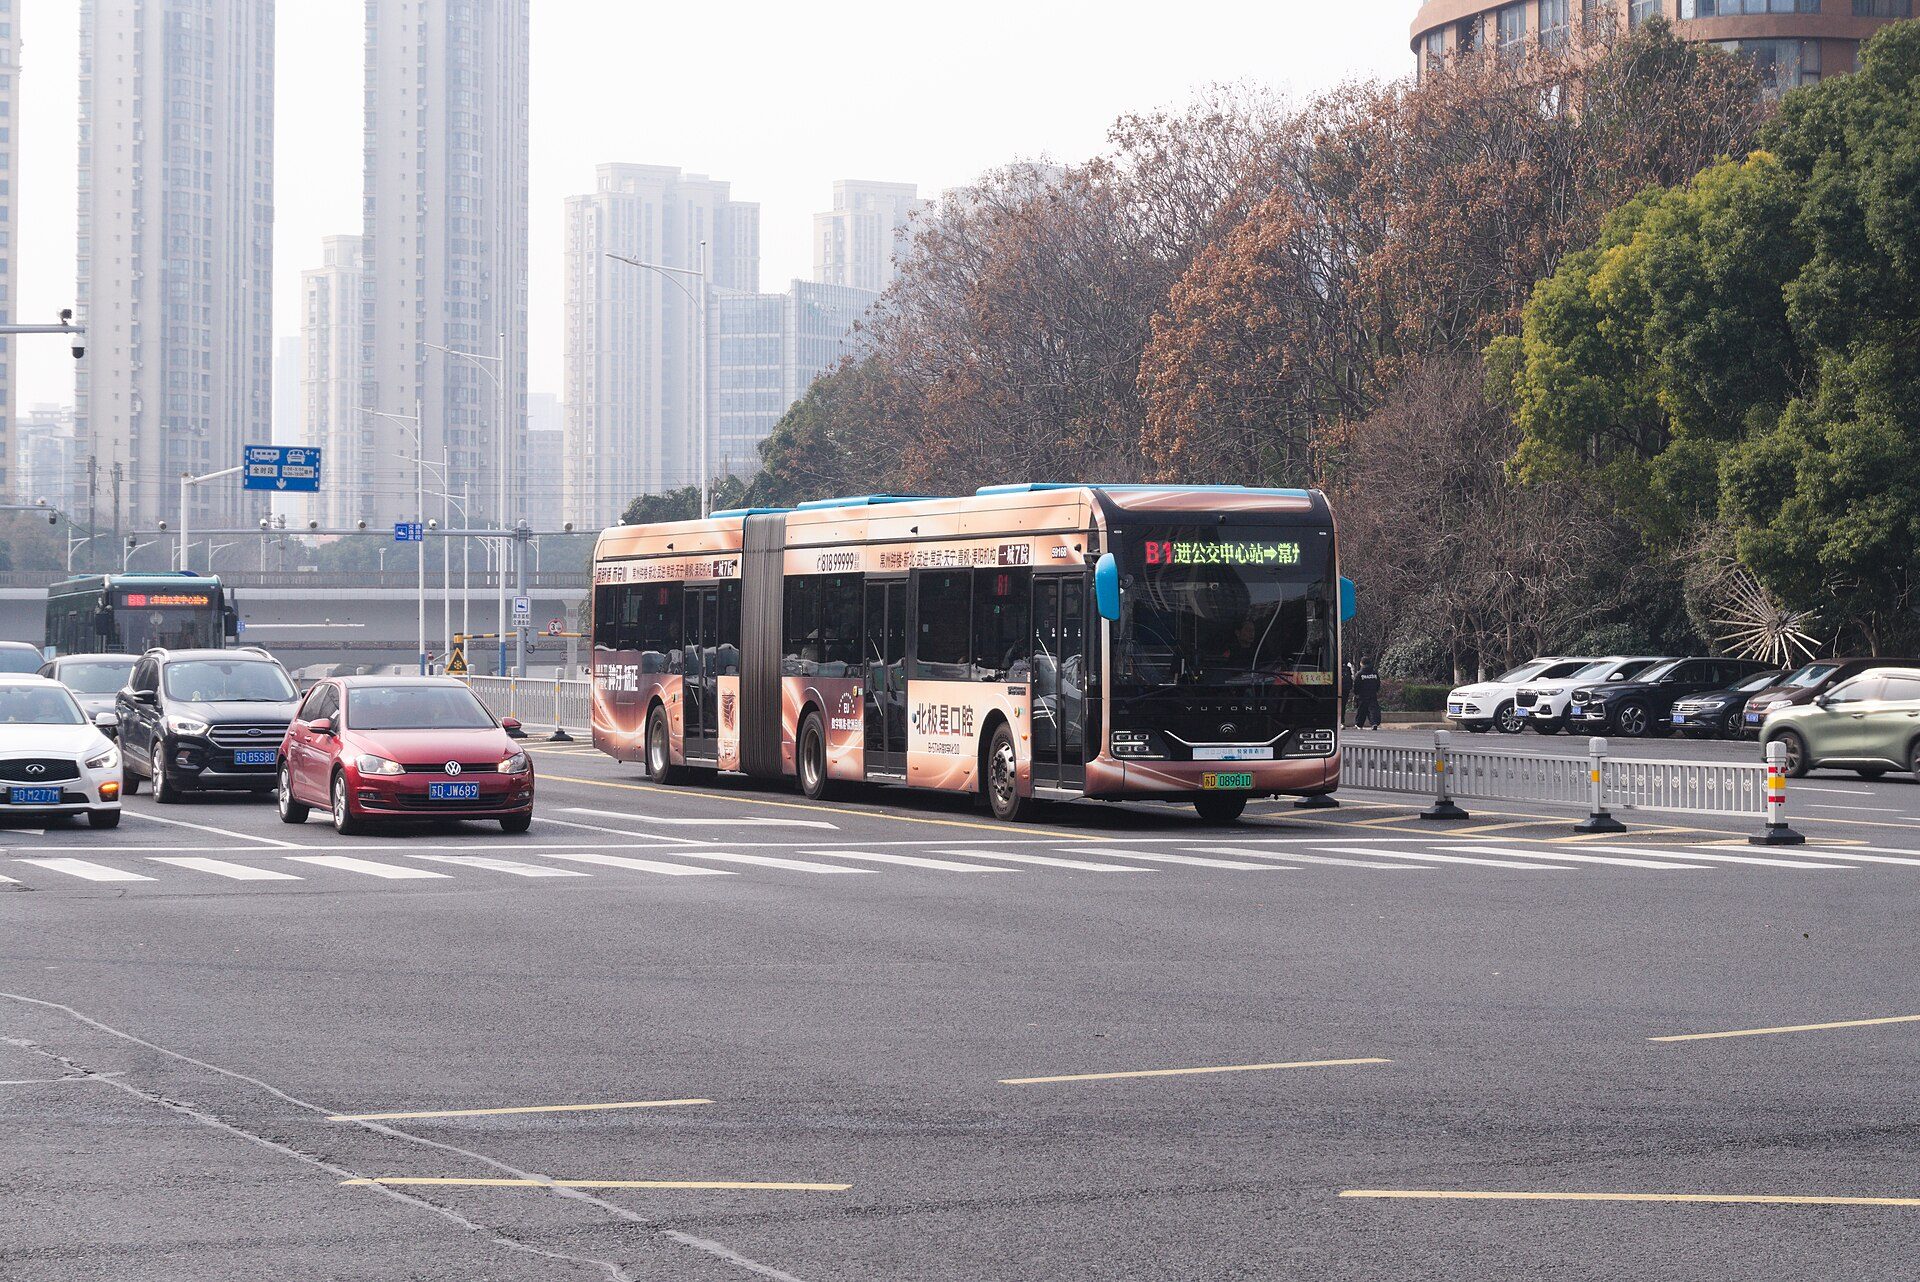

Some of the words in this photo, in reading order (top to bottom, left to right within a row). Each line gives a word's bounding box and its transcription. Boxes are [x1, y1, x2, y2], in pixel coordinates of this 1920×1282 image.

[916, 703, 974, 737] 北极星口腔
